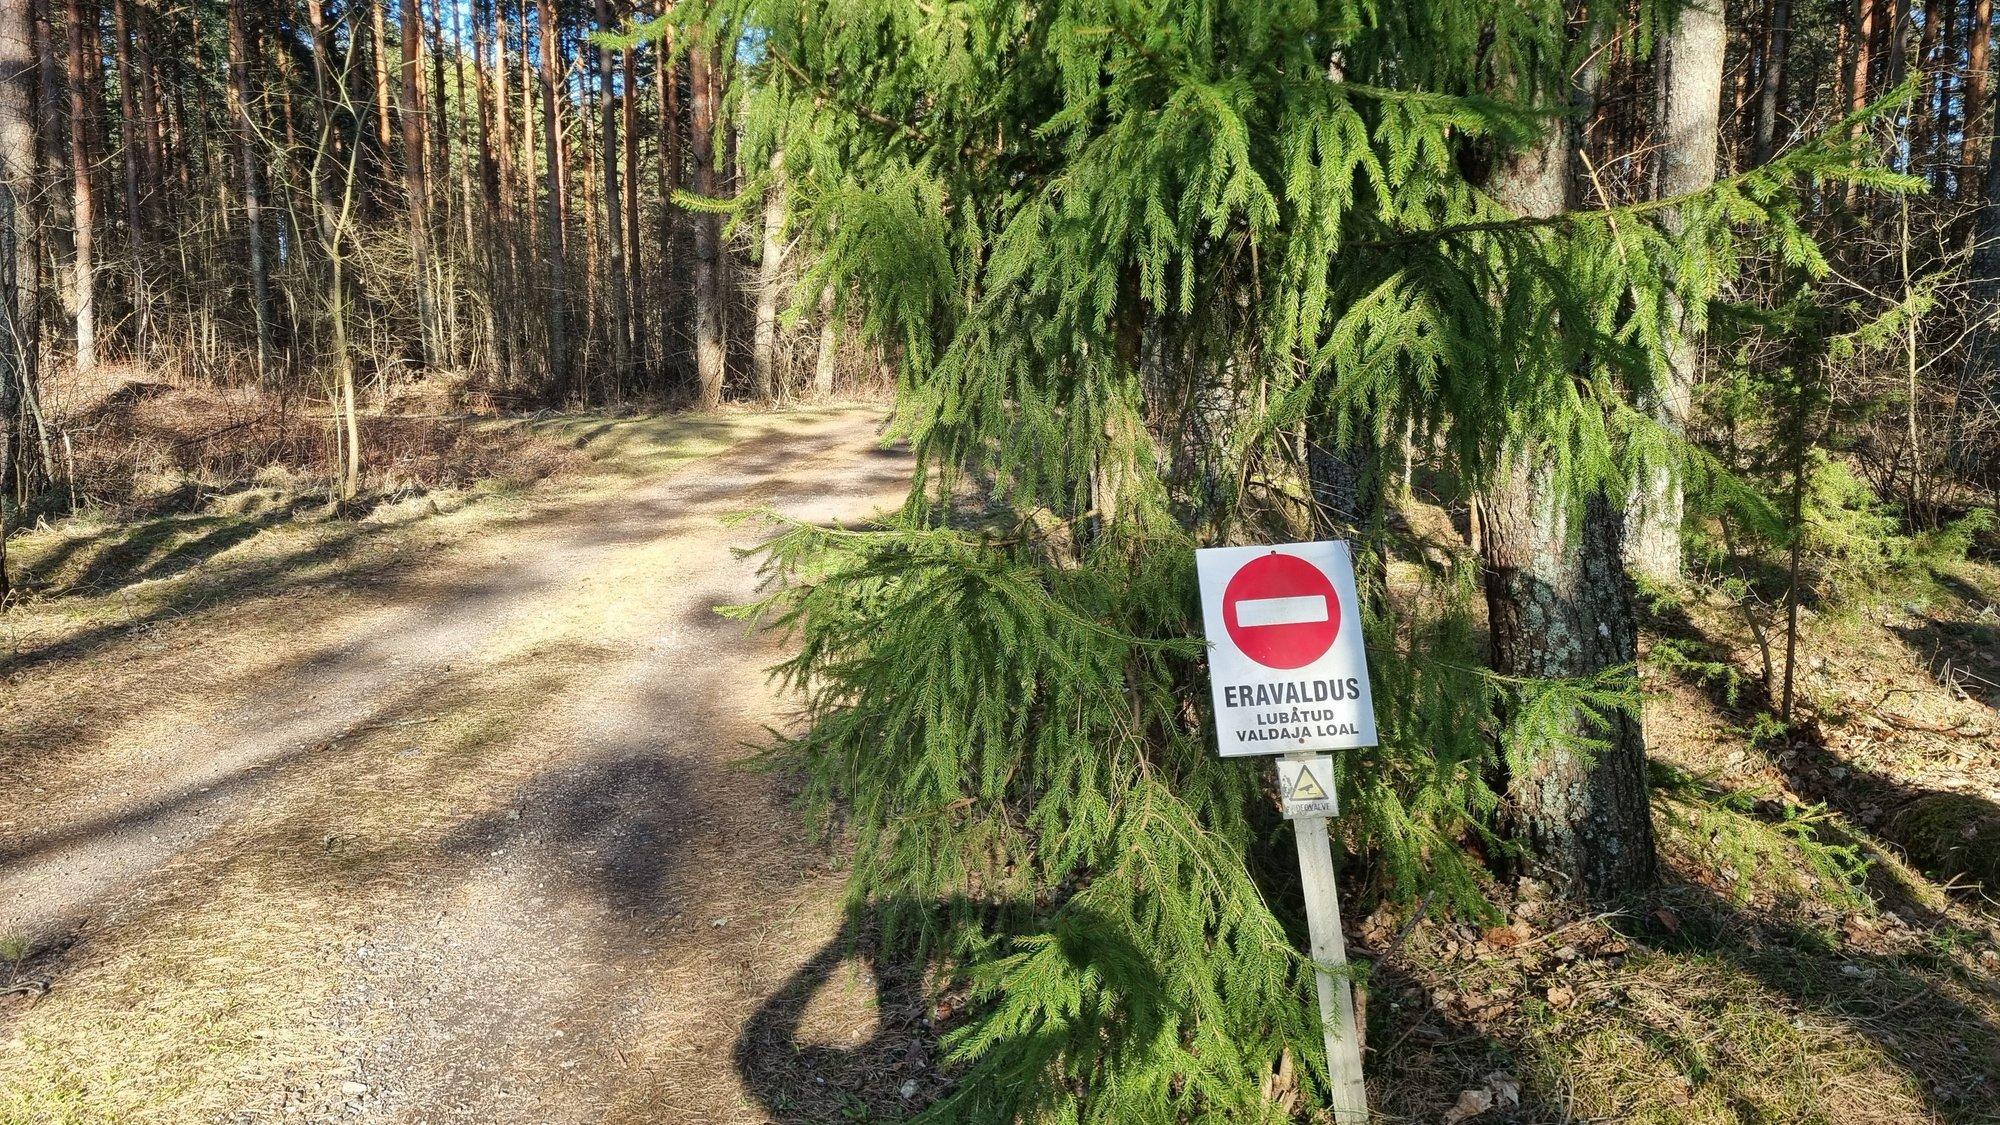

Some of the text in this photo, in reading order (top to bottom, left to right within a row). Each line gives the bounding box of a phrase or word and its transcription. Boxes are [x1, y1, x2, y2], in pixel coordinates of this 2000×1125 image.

[1224, 678, 1360, 708] ERAVALDUS
[1236, 723, 1359, 742] VALDAJA LOAL
